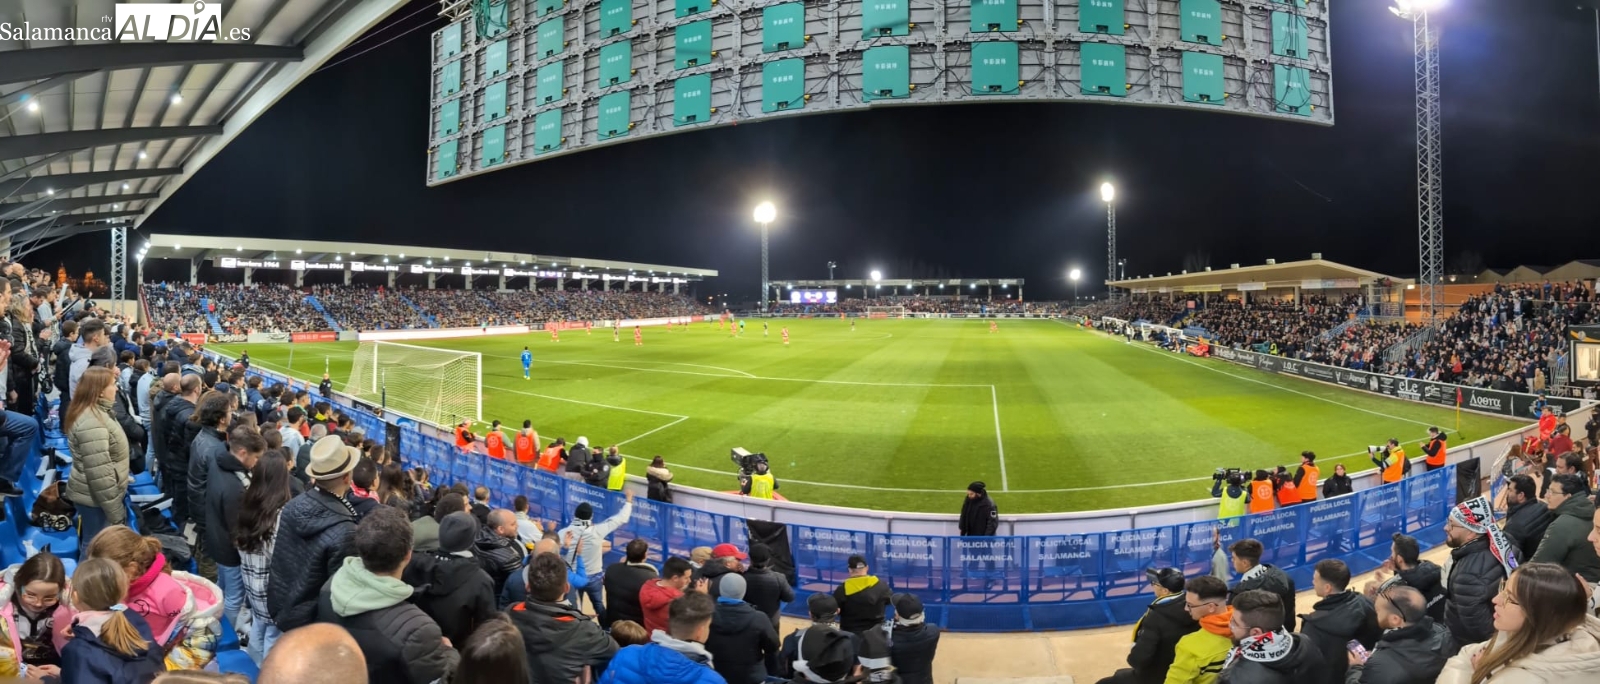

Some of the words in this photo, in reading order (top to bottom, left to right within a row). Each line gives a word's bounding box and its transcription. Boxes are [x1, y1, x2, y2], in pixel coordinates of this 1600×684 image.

[1333, 498, 1351, 507] LOCAL
[1276, 510, 1297, 519] LOCAL
[1312, 510, 1350, 524] SALAMANCA
[1253, 522, 1295, 537] SALAMANCA
[1142, 531, 1167, 541] LOCAL
[911, 539, 938, 548] LOCAL
[990, 541, 1016, 549] LOCAL
[1114, 544, 1164, 556] SALAMANCA
[882, 551, 935, 561] SALAMANCA
[960, 554, 1014, 562] SALAMANCA
[1038, 551, 1092, 561] SALAMANCA
